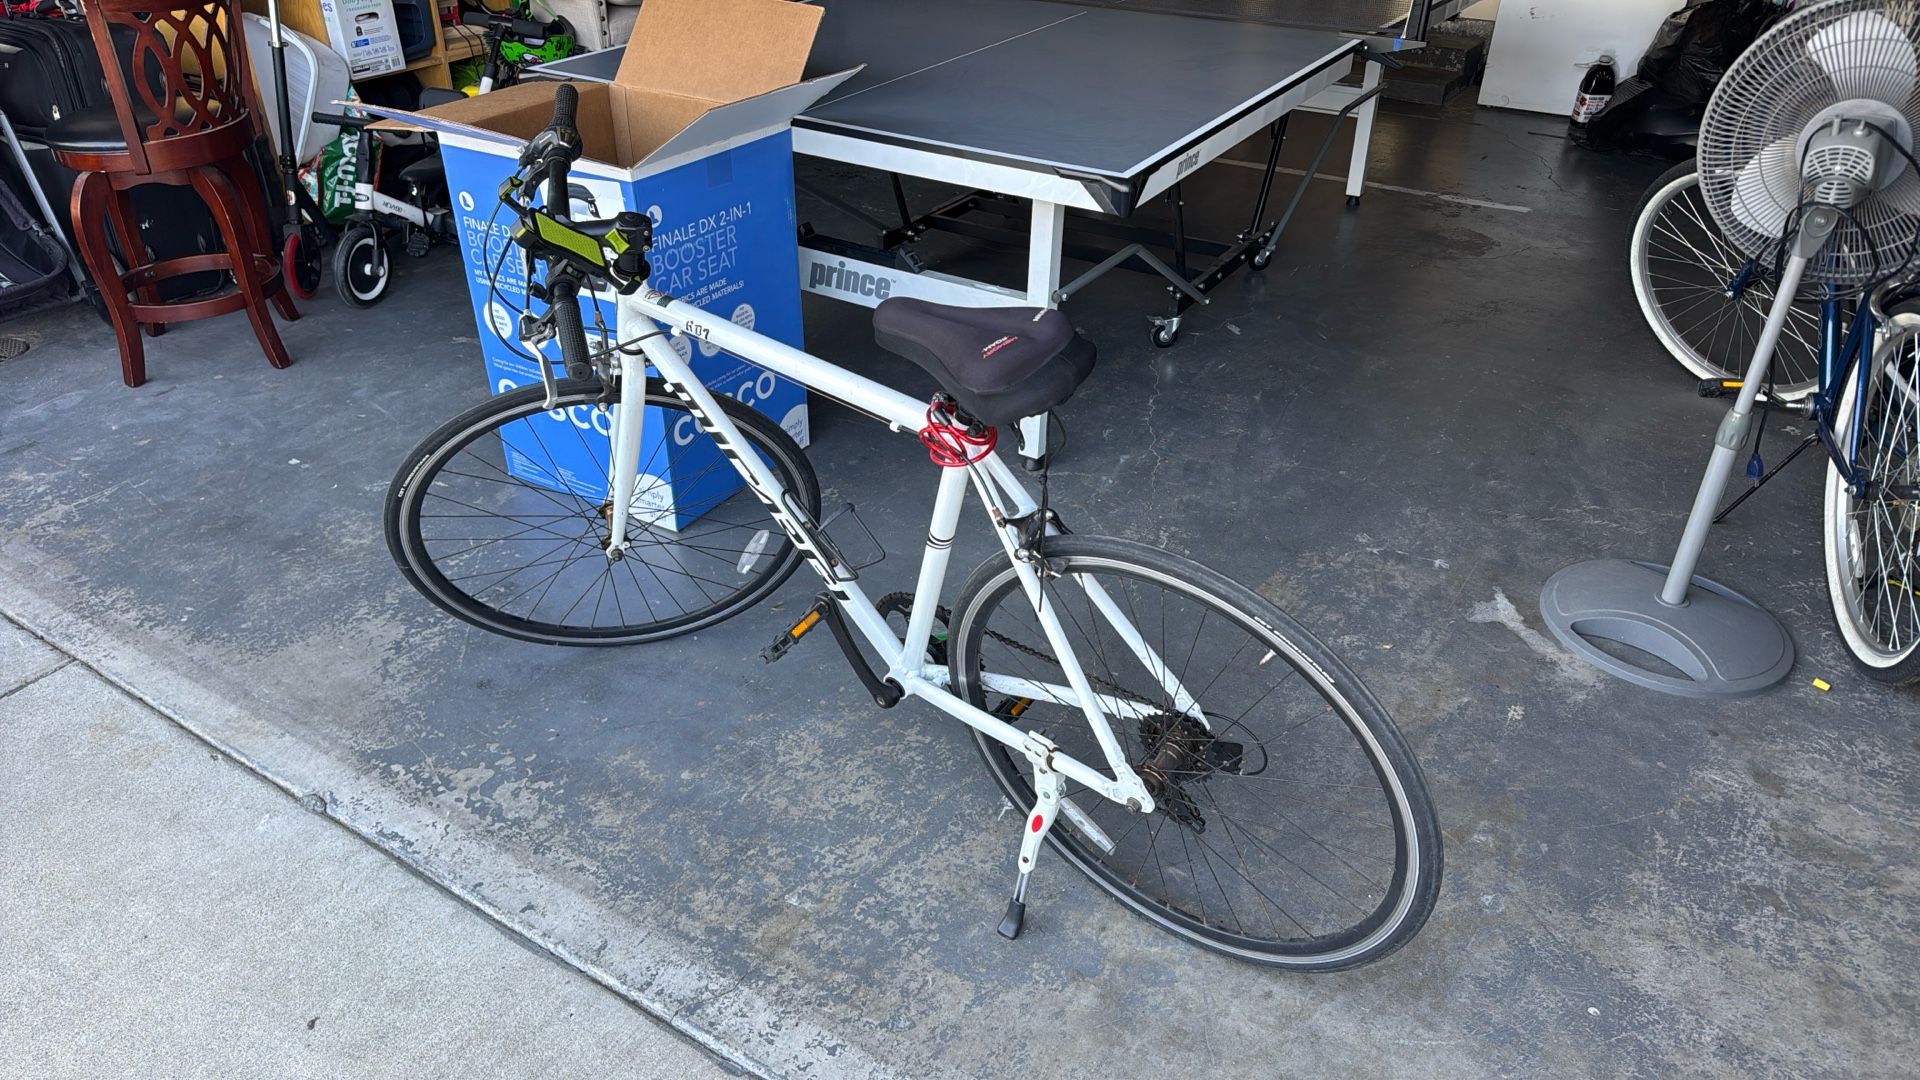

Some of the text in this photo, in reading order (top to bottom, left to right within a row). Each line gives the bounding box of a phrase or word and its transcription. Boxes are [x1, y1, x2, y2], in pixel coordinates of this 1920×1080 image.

[1175, 151, 1200, 180] prince
[501, 225, 511, 237] D
[652, 201, 752, 253] FINALE DX 2-IN-1
[466, 230, 521, 259] BOOST
[652, 225, 737, 277] BOOSTER
[505, 257, 545, 281] SET
[655, 246, 738, 297] CAR SEAT
[809, 260, 892, 300] prince
[475, 276, 491, 287] USIN
[494, 282, 521, 296] ECYCLED
[695, 286, 708, 298] ARE
[708, 277, 728, 291] MADE
[711, 280, 745, 303] MATERIALS!
